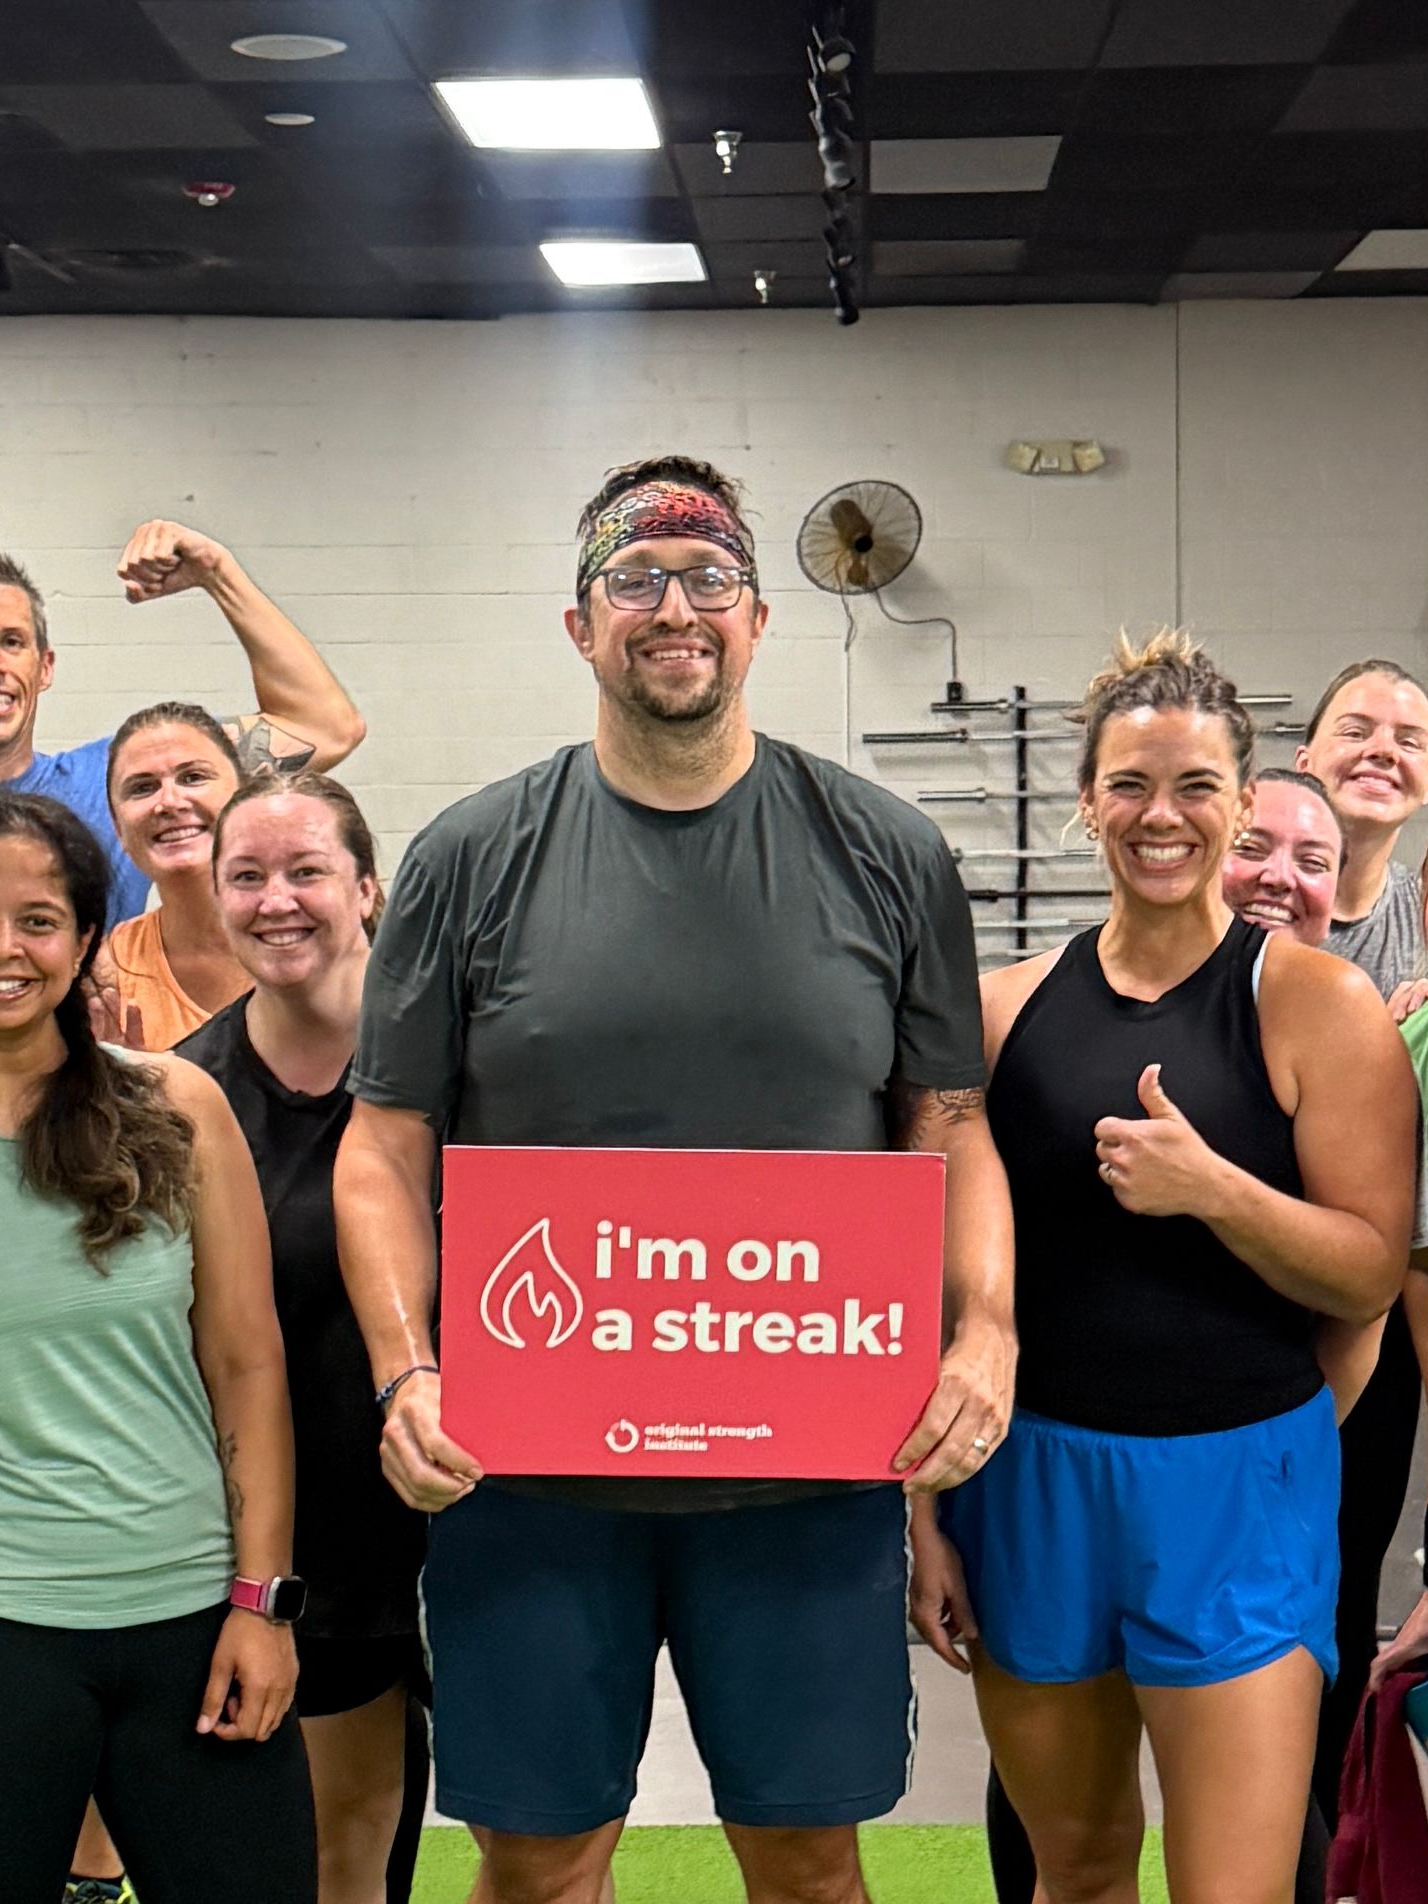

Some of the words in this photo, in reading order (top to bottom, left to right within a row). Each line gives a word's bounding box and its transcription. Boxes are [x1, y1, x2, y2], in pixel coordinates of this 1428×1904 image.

[595, 1219, 707, 1280] i'm
[726, 1239, 820, 1282] on
[591, 1308, 633, 1351] a
[652, 1298, 904, 1355] streak!
